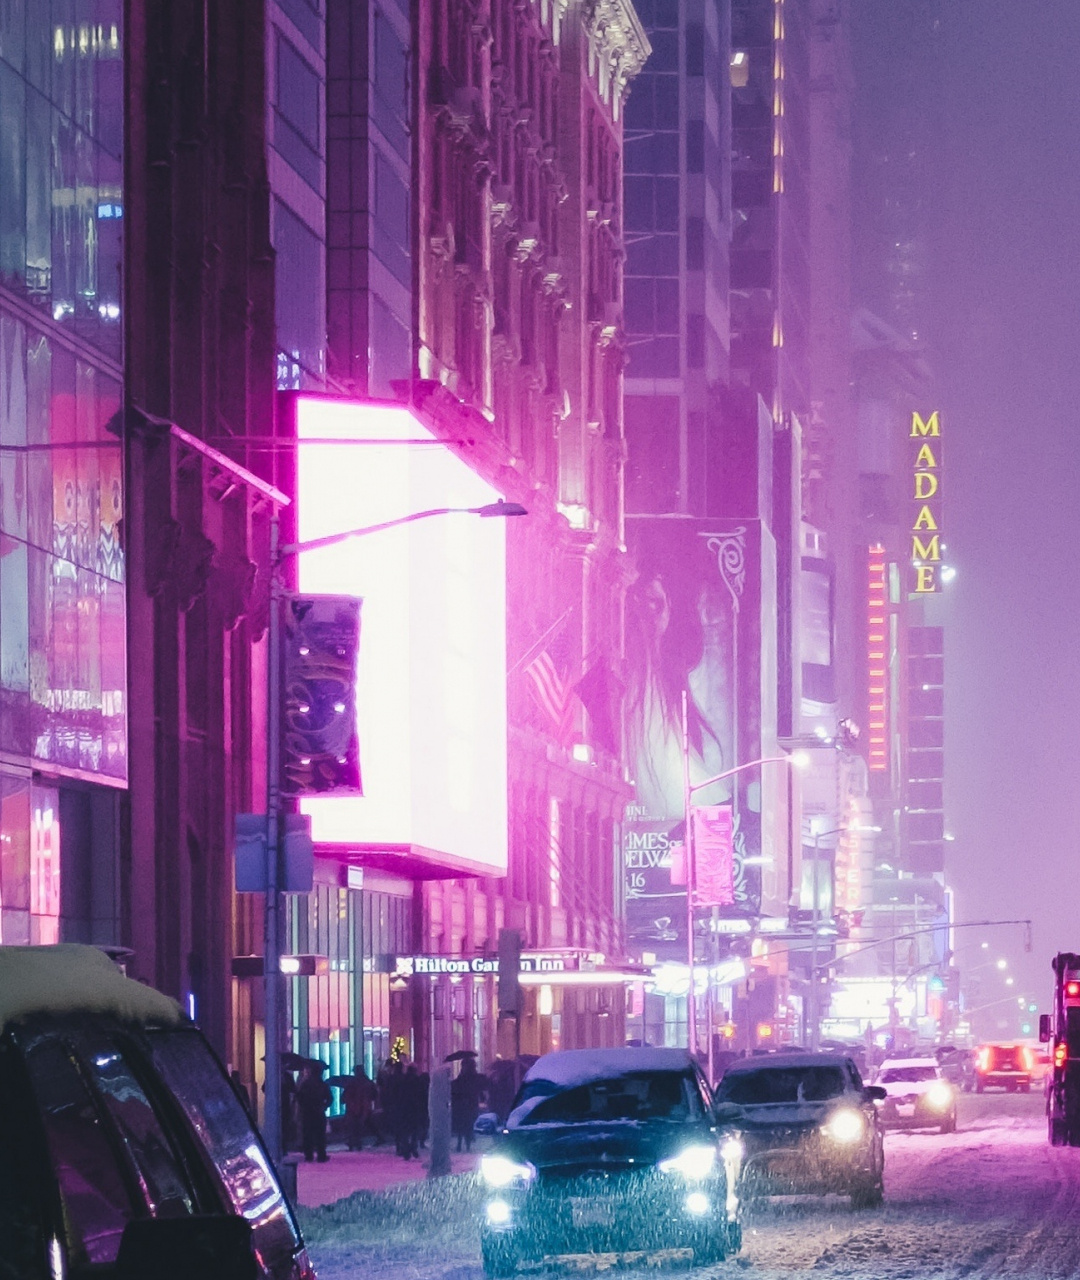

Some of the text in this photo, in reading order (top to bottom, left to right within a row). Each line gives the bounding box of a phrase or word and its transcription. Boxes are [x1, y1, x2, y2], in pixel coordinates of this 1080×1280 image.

[909, 410, 941, 592] MADAME
[625, 832, 669, 850] IMES
[625, 851, 672, 868] ELW
[630, 872, 645, 887] 16
[415, 957, 470, 973] Hilton
[471, 957, 530, 973] Garn
[535, 956, 564, 971] Inn
